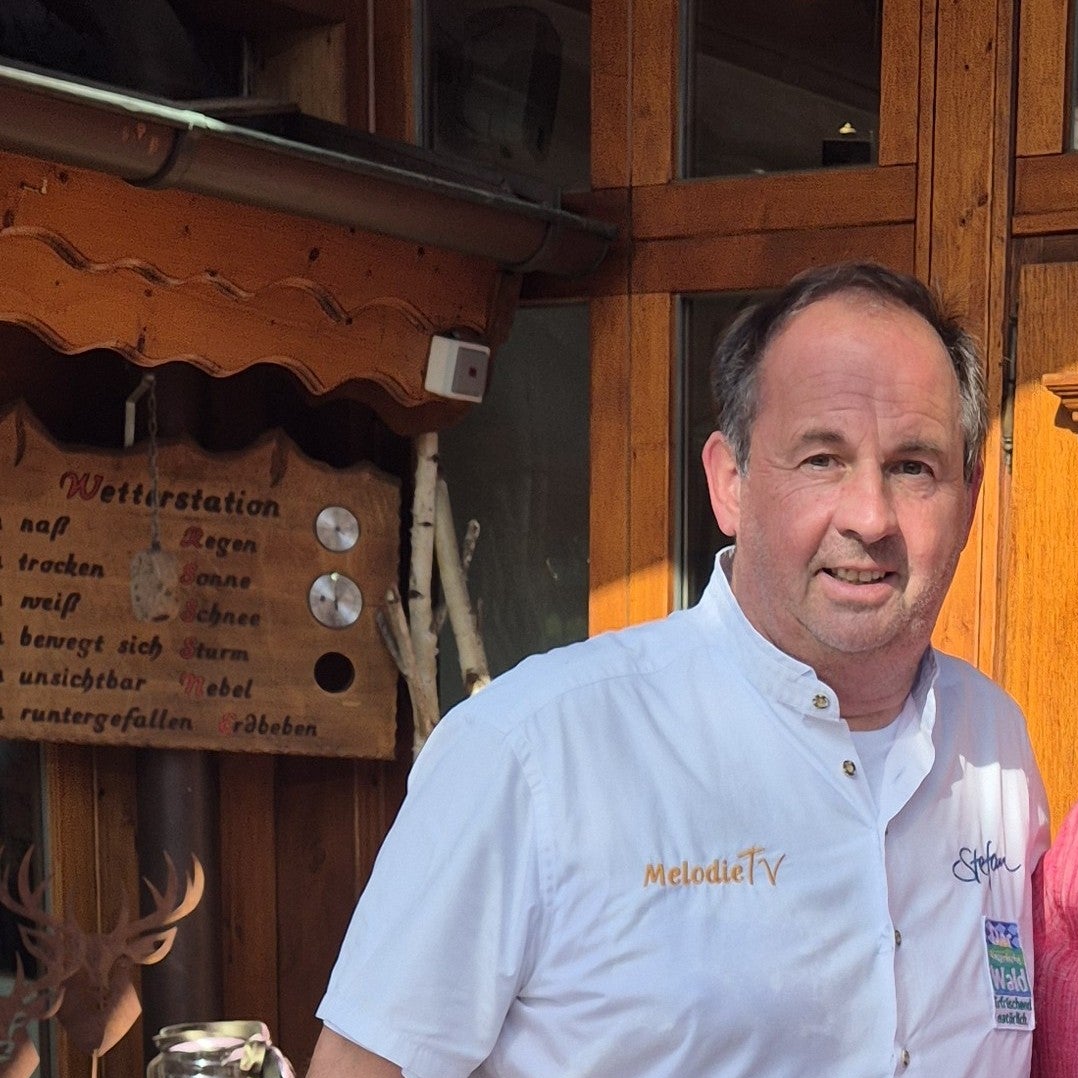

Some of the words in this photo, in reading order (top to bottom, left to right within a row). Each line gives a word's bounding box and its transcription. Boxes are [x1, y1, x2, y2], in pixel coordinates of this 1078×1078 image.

[59, 471, 280, 518] Wetterstation
[20, 515, 71, 542] naß
[179, 525, 258, 559] Regen
[18, 553, 105, 579] trocken
[179, 562, 252, 589] Sonne
[20, 591, 82, 621] weiß
[179, 599, 262, 629] Schnee
[19, 624, 105, 660] bewegt
[117, 634, 164, 662] sich
[179, 636, 250, 662] Sturm
[18, 666, 148, 694] unsichtbar
[178, 671, 254, 700] Nebel
[20, 705, 194, 734] runtergefallen
[217, 711, 318, 738] Erdbeben
[952, 839, 1022, 891] Stefan
[990, 965, 1030, 992] Wald
